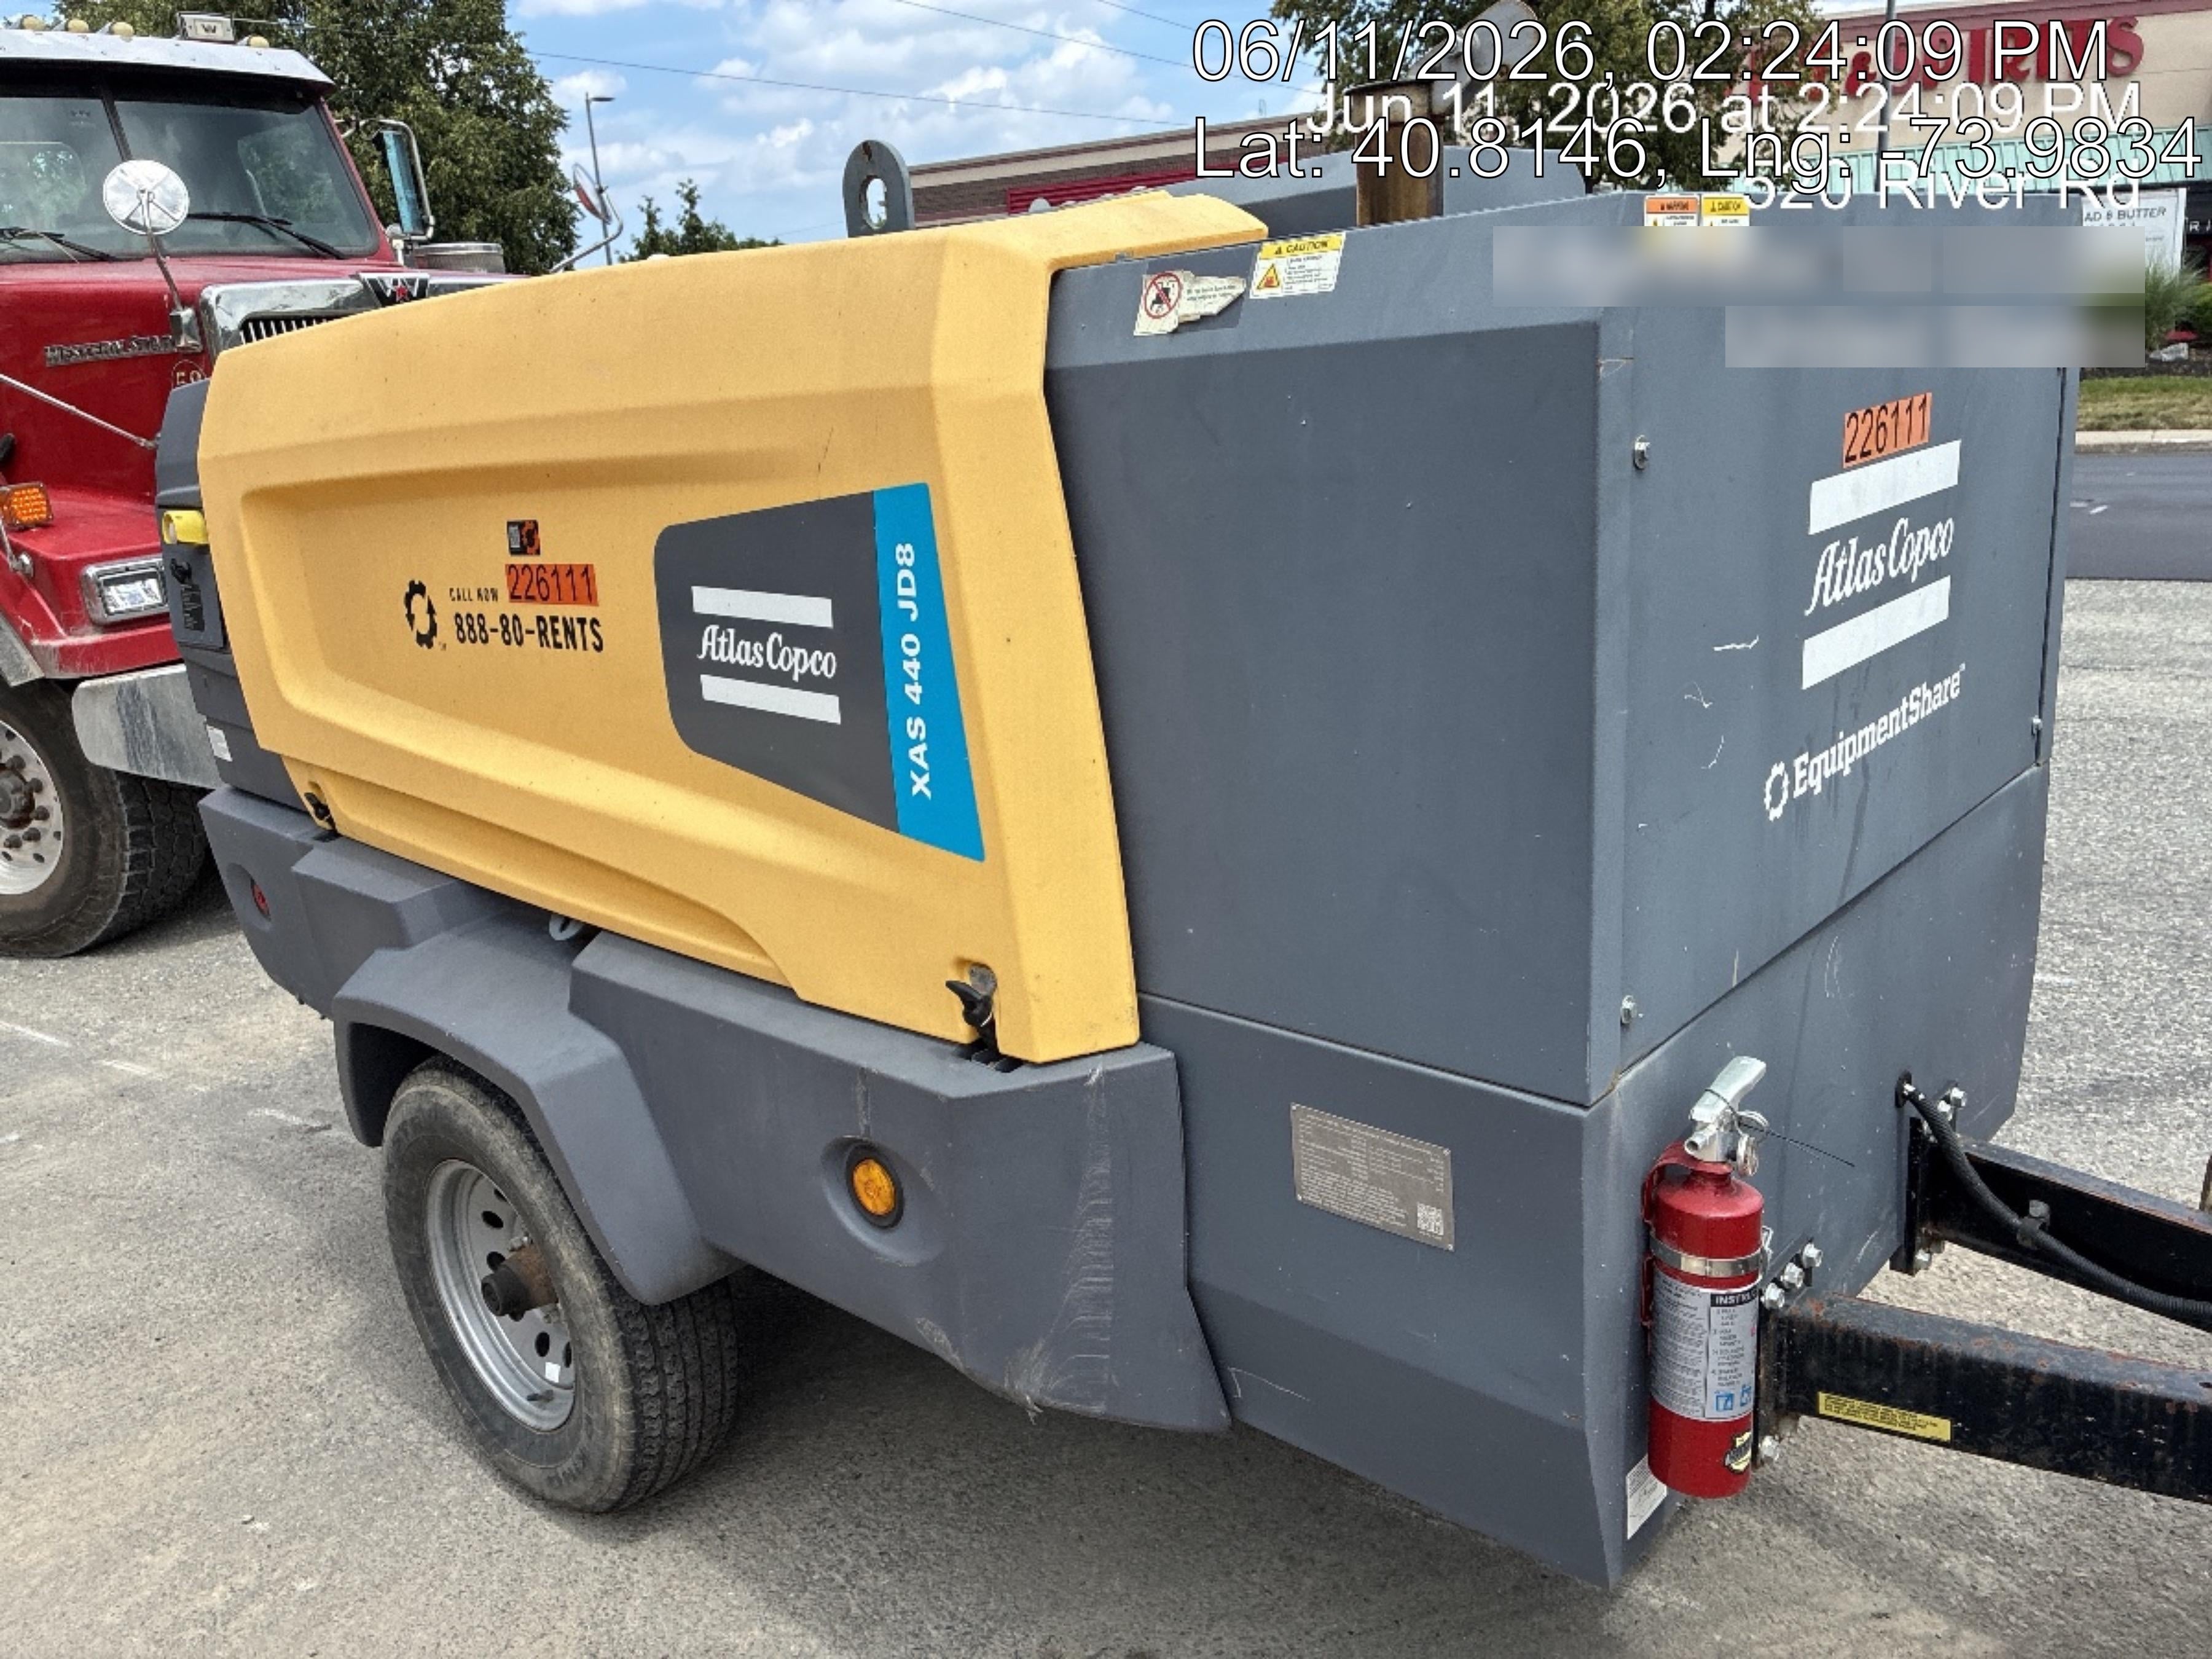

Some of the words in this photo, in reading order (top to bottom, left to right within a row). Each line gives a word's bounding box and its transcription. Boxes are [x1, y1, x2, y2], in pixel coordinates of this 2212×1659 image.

[2117, 206, 2167, 220] BUTTER
[1844, 393, 1928, 463] 226111
[449, 587, 473, 602] CALL
[477, 587, 498, 603] NOW
[508, 563, 594, 603] 226111
[895, 542, 918, 622] JD8
[1804, 535, 1886, 615] Atlas
[1888, 517, 1955, 583] Copco
[454, 612, 605, 653] 888-80-RENTS
[696, 624, 764, 668] Atlas
[766, 632, 837, 683] Copco
[900, 633, 922, 705] 440
[906, 716, 931, 801] XAS
